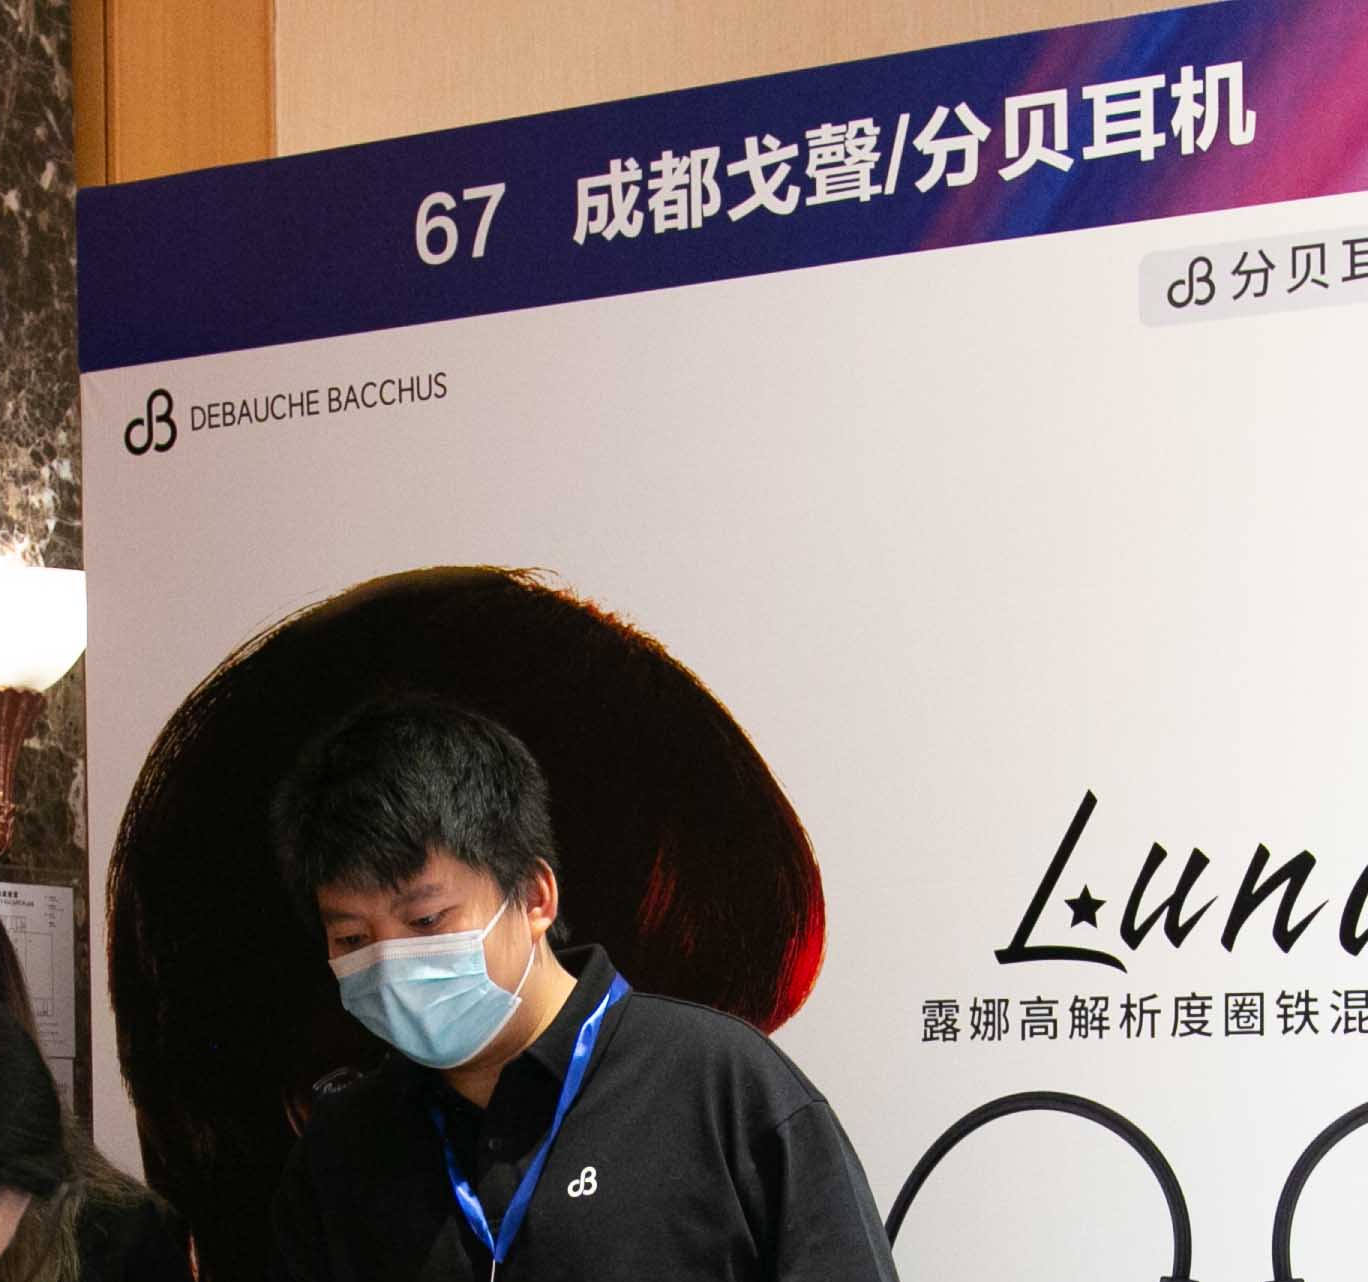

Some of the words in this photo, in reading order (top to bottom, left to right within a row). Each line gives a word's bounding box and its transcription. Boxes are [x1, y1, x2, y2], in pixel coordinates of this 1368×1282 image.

[415, 183, 507, 266] 67
[573, 61, 1256, 245] 成都戈聲/分贝耳机
[191, 390, 320, 432] DEBAUCHE
[327, 371, 448, 413] BACCHUS
